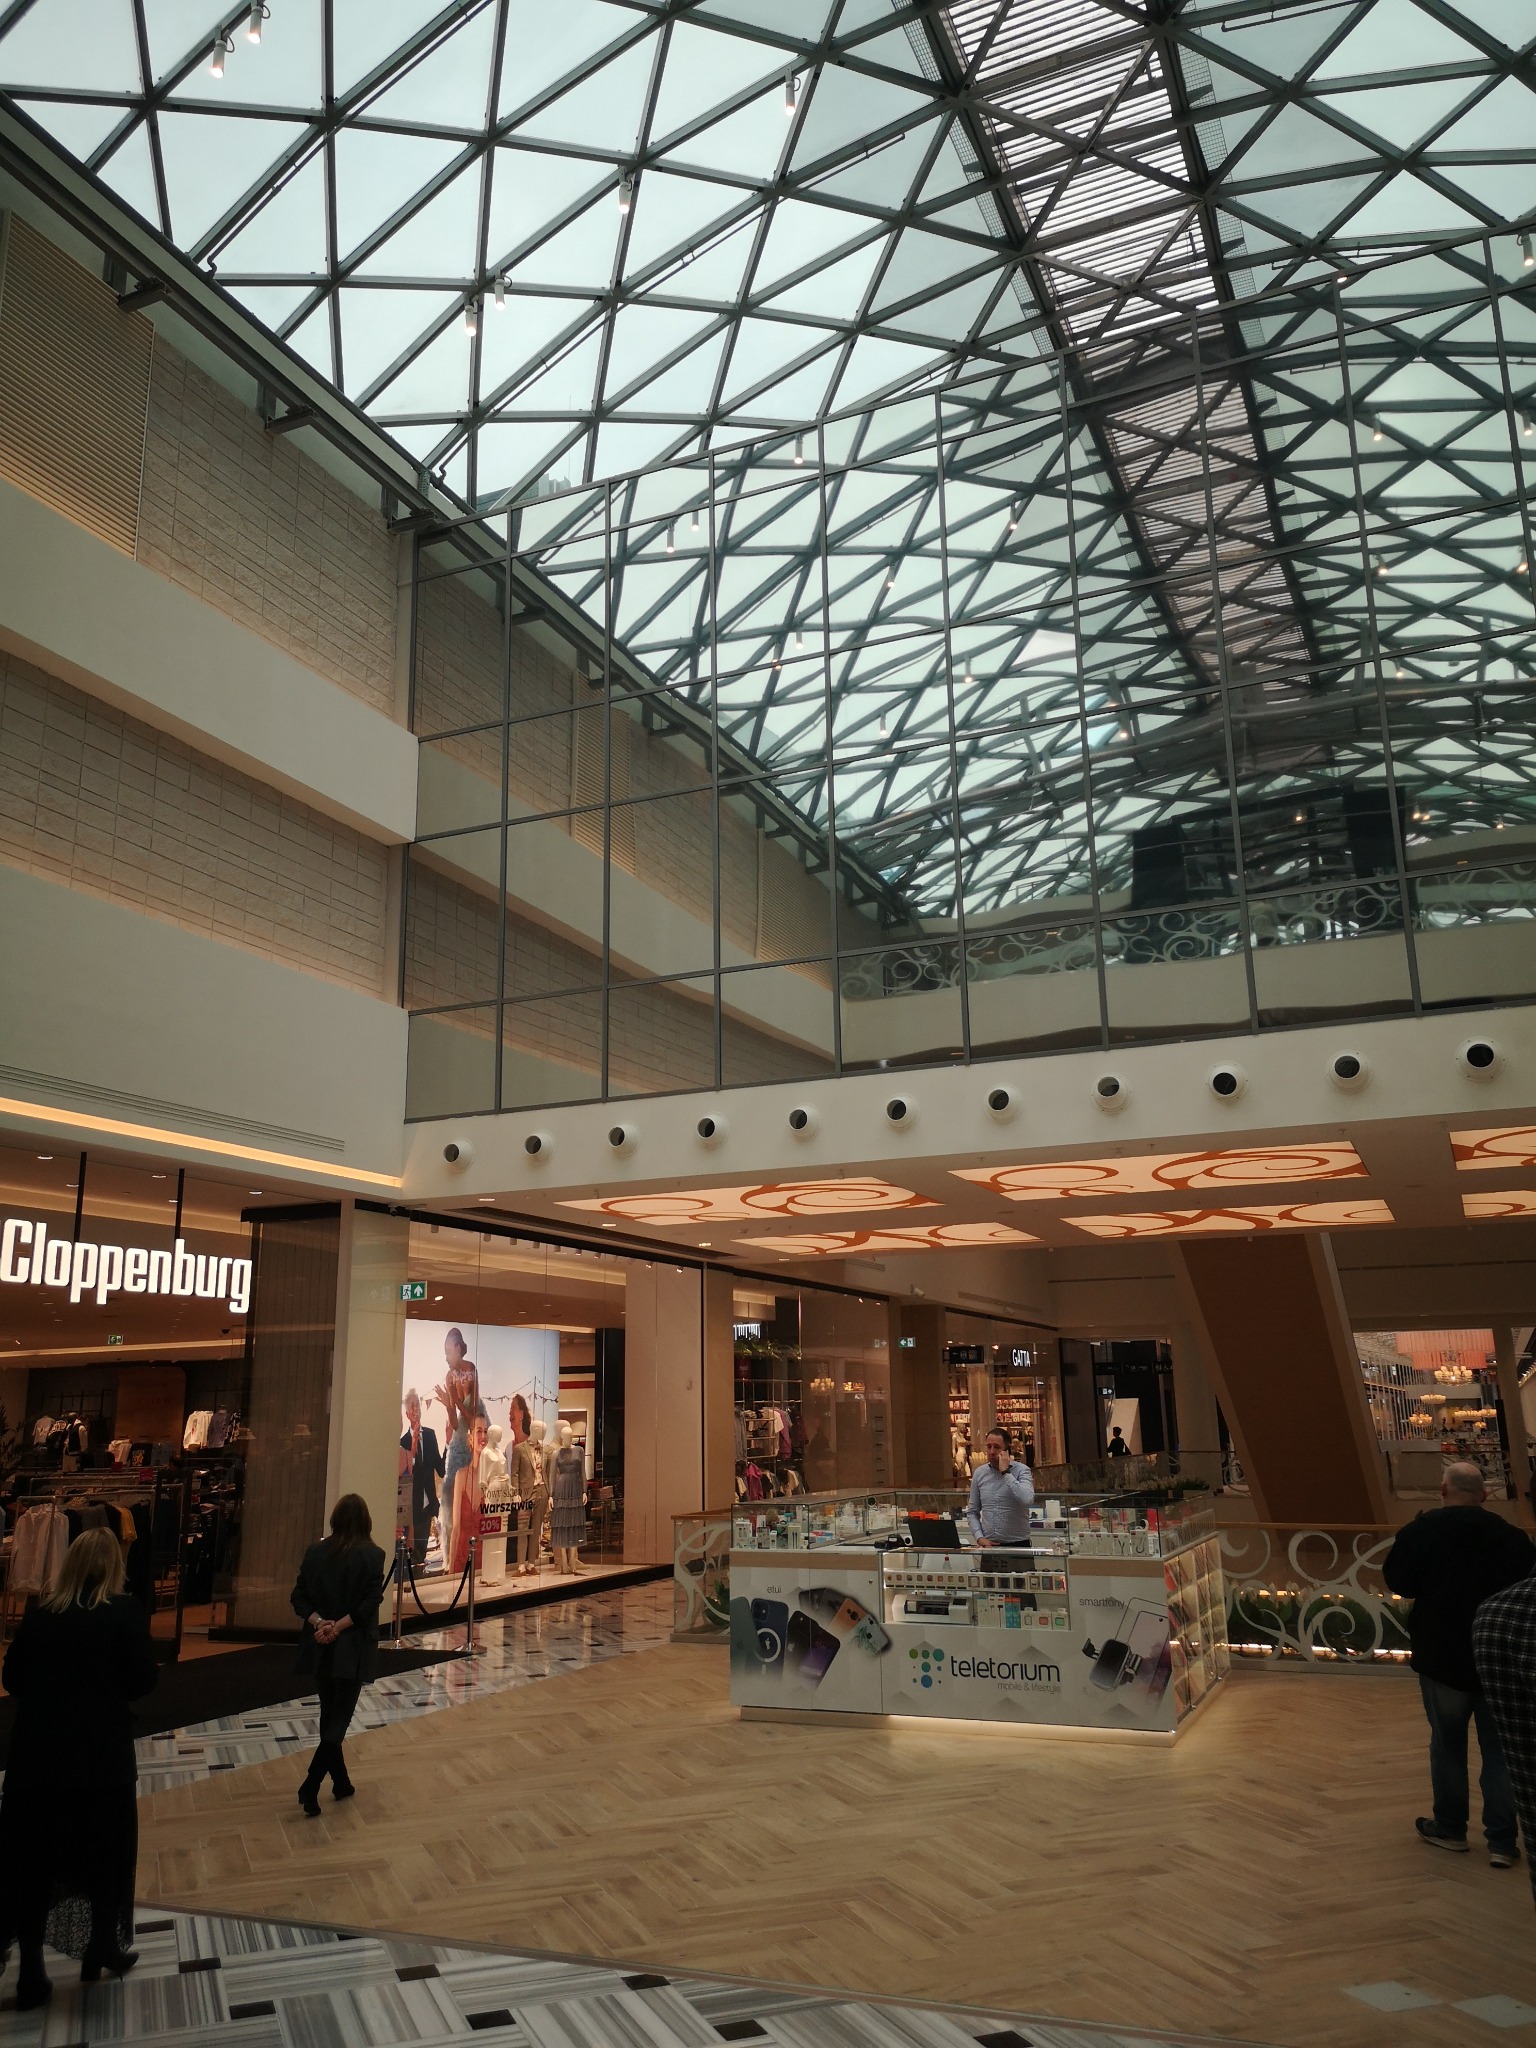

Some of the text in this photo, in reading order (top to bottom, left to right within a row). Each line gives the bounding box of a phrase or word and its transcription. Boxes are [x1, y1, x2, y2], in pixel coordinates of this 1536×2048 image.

[0, 1218, 253, 1314] Cloppenburg
[1012, 1349, 1031, 1367] GATTA
[480, 1499, 533, 1515] Warszawie
[481, 1518, 500, 1532] 20%
[1079, 1597, 1125, 1610] smartfony
[950, 1655, 1061, 1682] teletorium
[997, 1681, 1062, 1695] mobile & lifestyle
